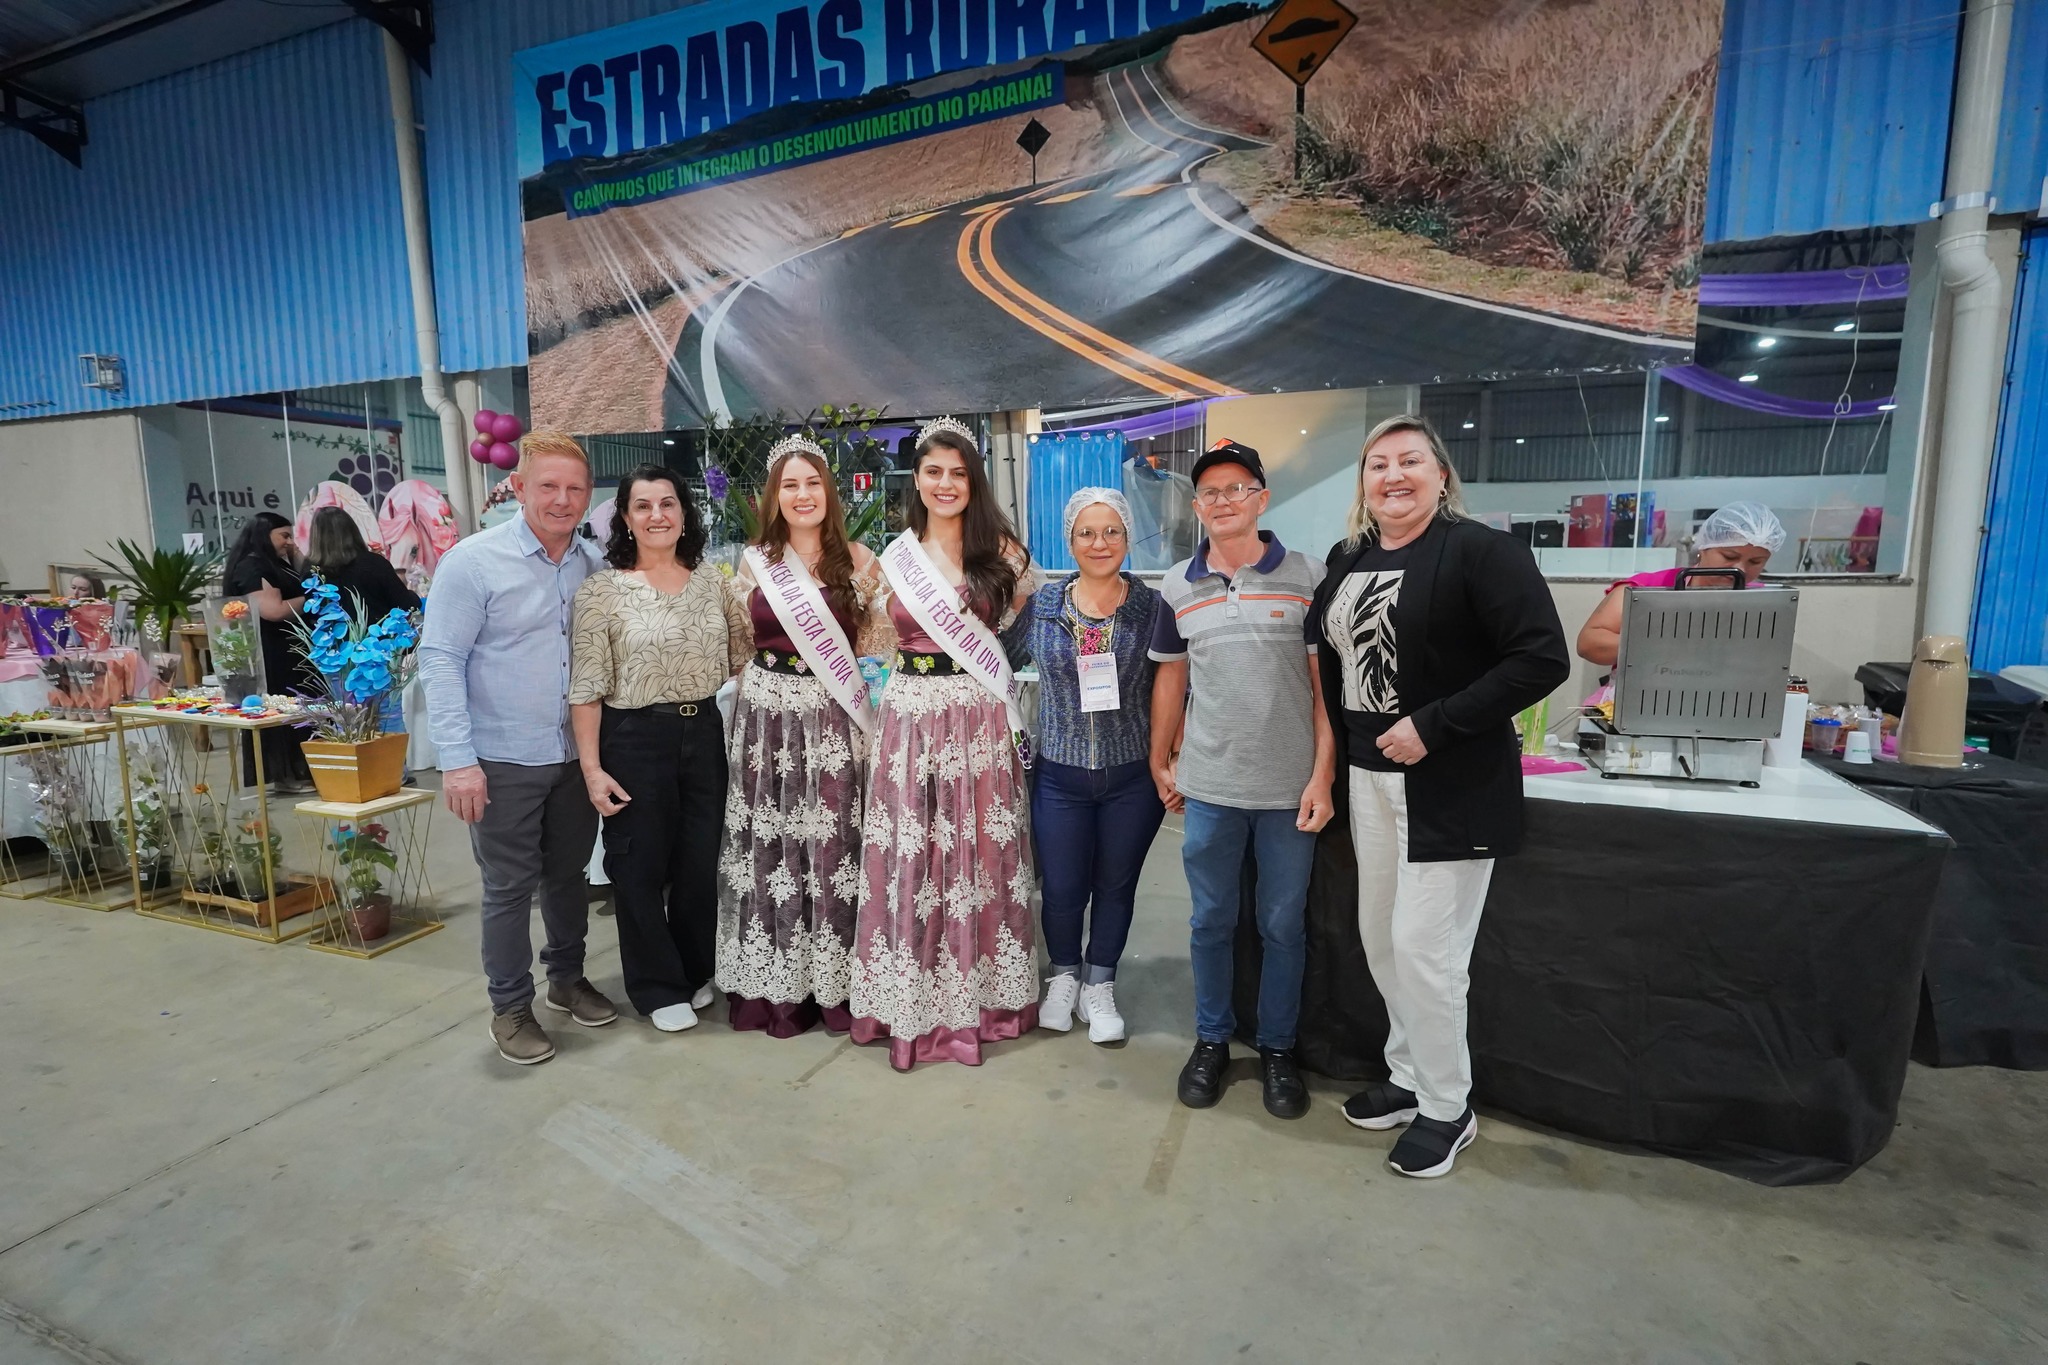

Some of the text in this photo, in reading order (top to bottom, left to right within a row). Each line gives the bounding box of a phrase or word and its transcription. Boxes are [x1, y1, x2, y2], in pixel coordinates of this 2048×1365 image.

[535, 0, 867, 170] ESTRADAS
[647, 168, 675, 196] QUE
[677, 153, 755, 188] INTEGRAM
[759, 150, 770, 168] O
[773, 103, 933, 165] DESENVOLVIMENTO
[937, 95, 963, 124] NO
[968, 72, 1053, 117] PARANÁ!
[186, 482, 280, 513] Aqui é
[781, 585, 805, 605] DA
[892, 546, 928, 592] PRINCESA
[914, 582, 937, 605] DA
[927, 598, 966, 641] FESTA
[958, 632, 982, 658] DA
[976, 646, 1001, 679] UVA
[790, 600, 827, 642] FESTA
[815, 637, 839, 661] DA
[829, 654, 854, 686] UVA
